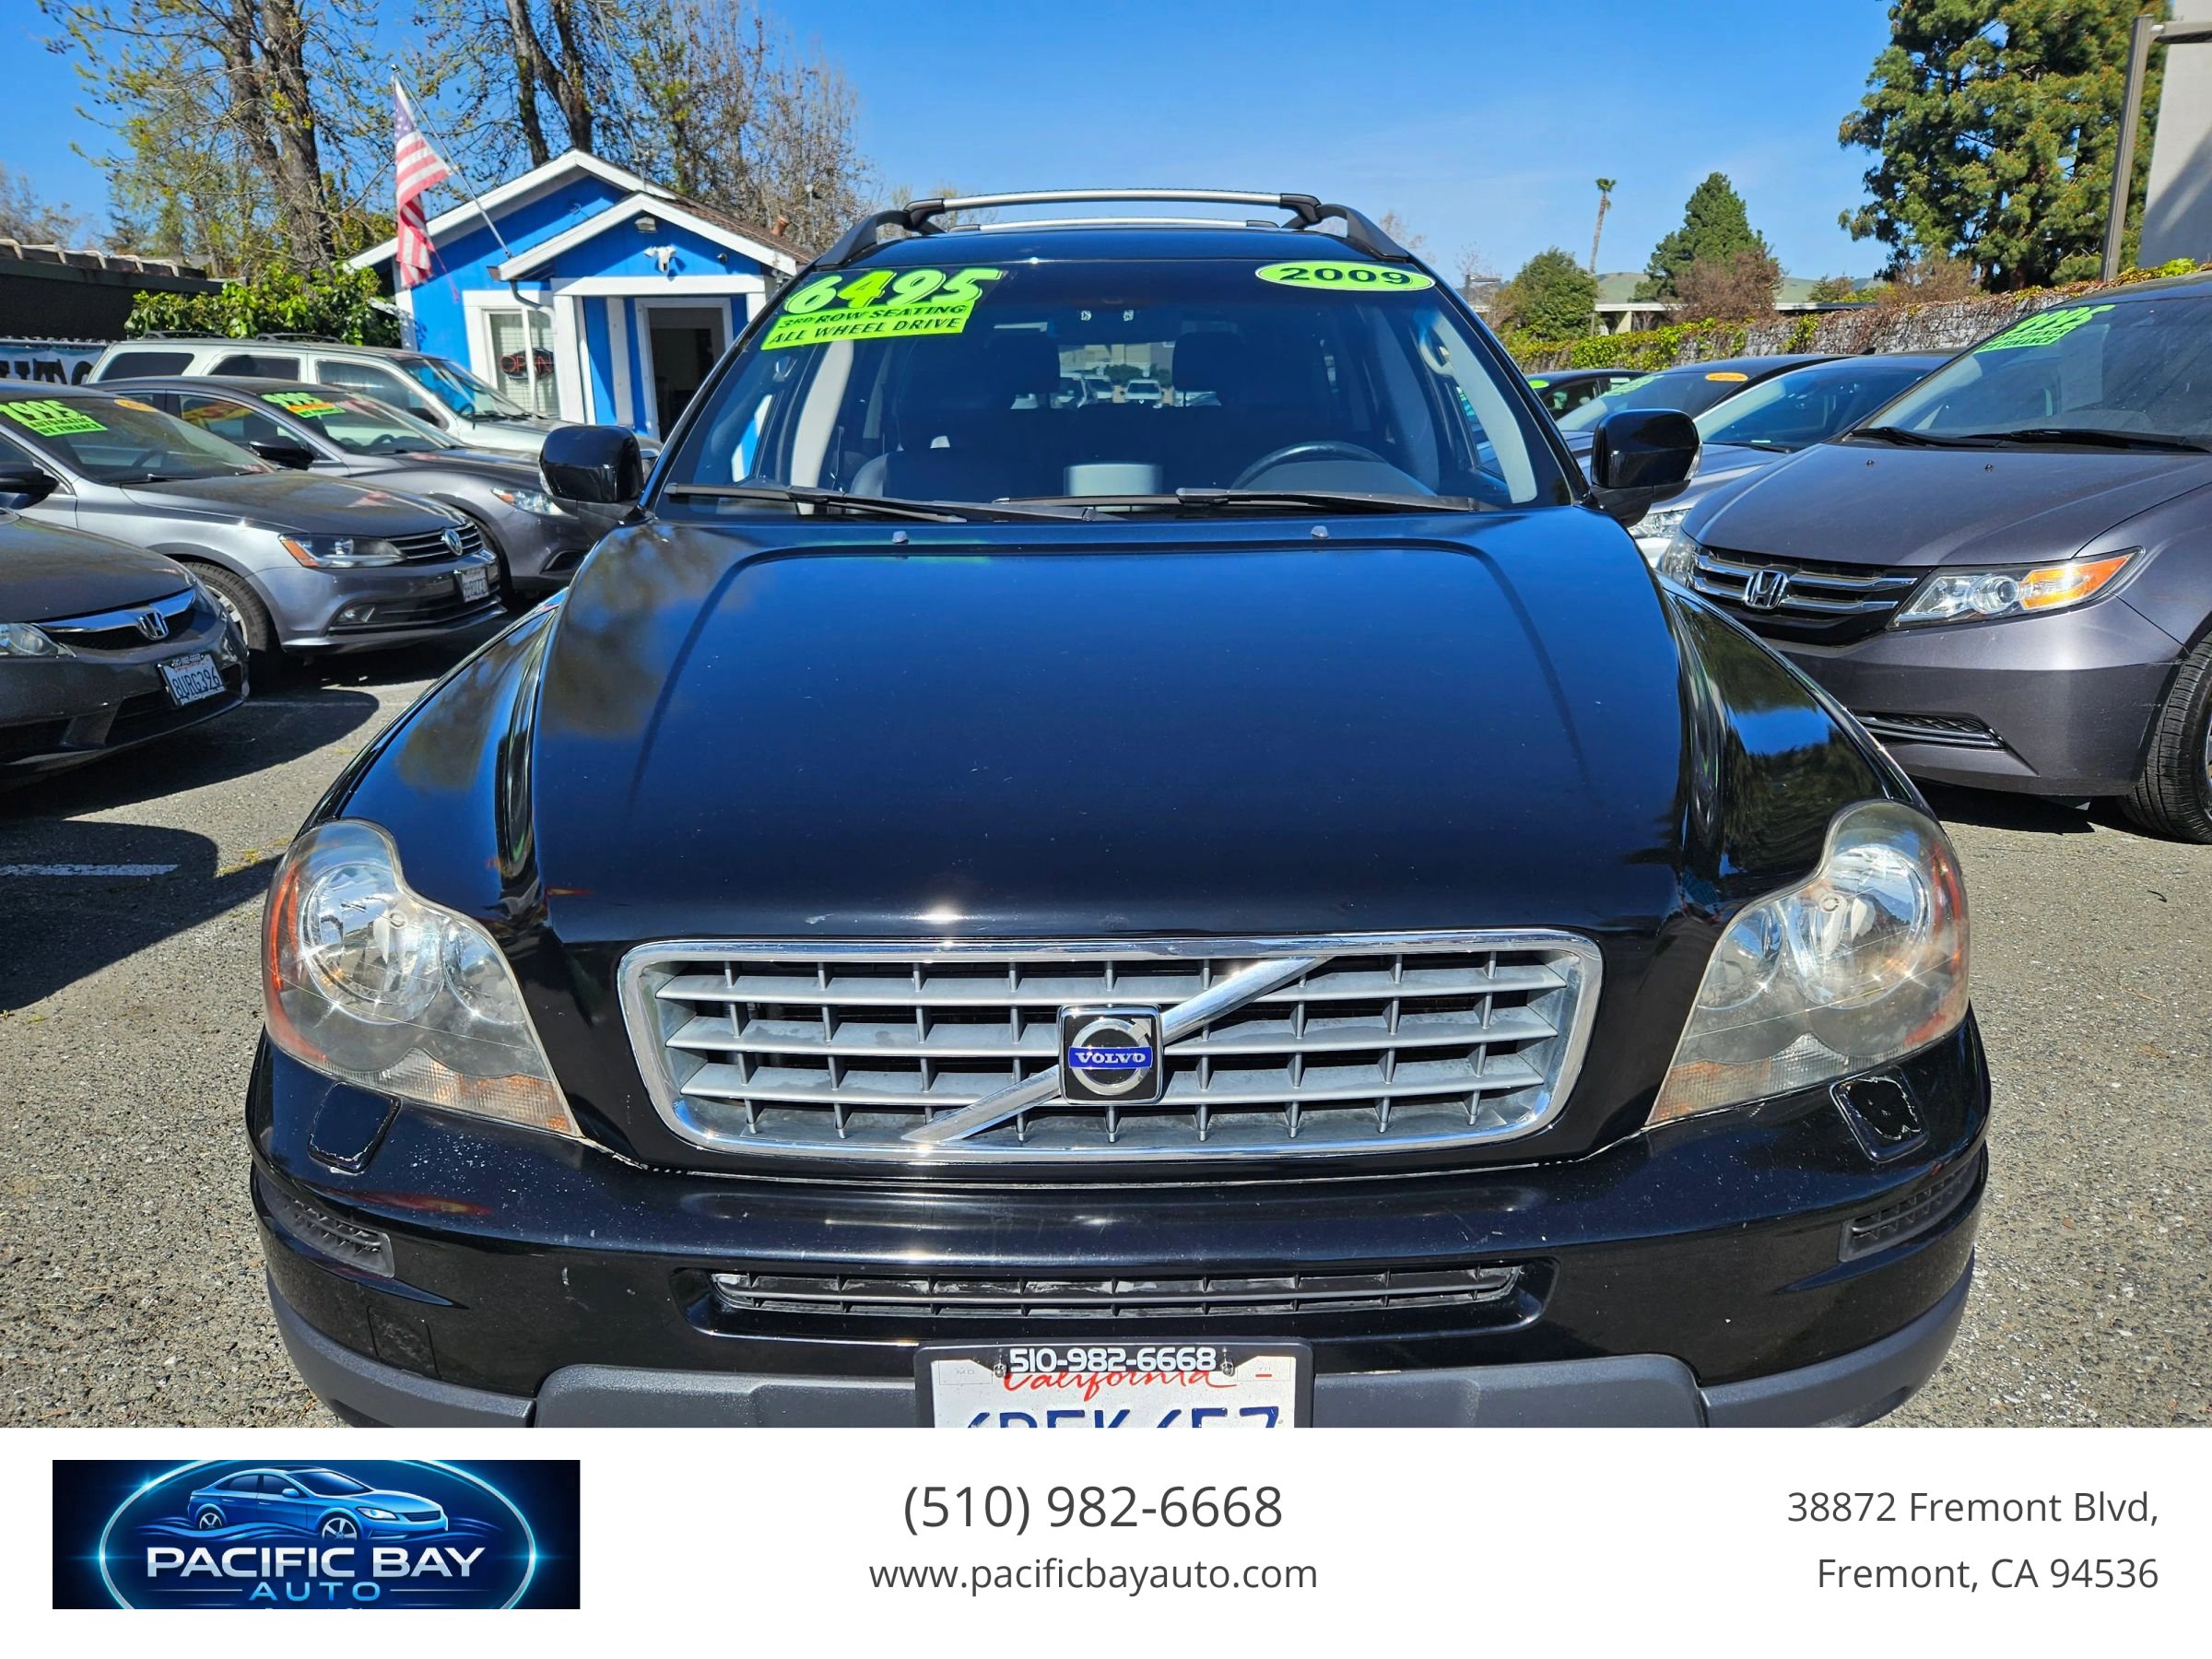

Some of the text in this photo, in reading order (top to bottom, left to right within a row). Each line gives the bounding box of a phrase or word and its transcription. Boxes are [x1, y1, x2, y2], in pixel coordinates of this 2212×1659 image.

[1279, 267, 1411, 284] 2009
[783, 268, 1003, 313] 6495
[778, 304, 967, 328] 3RD ROW SEATING
[768, 317, 963, 345] ALL WHEEL DRIVE
[500, 354, 553, 373] OPN
[172, 666, 221, 698] 8URG396
[1075, 1053, 1147, 1064] VOLVO
[1009, 1347, 1217, 1372] 510-982-6668
